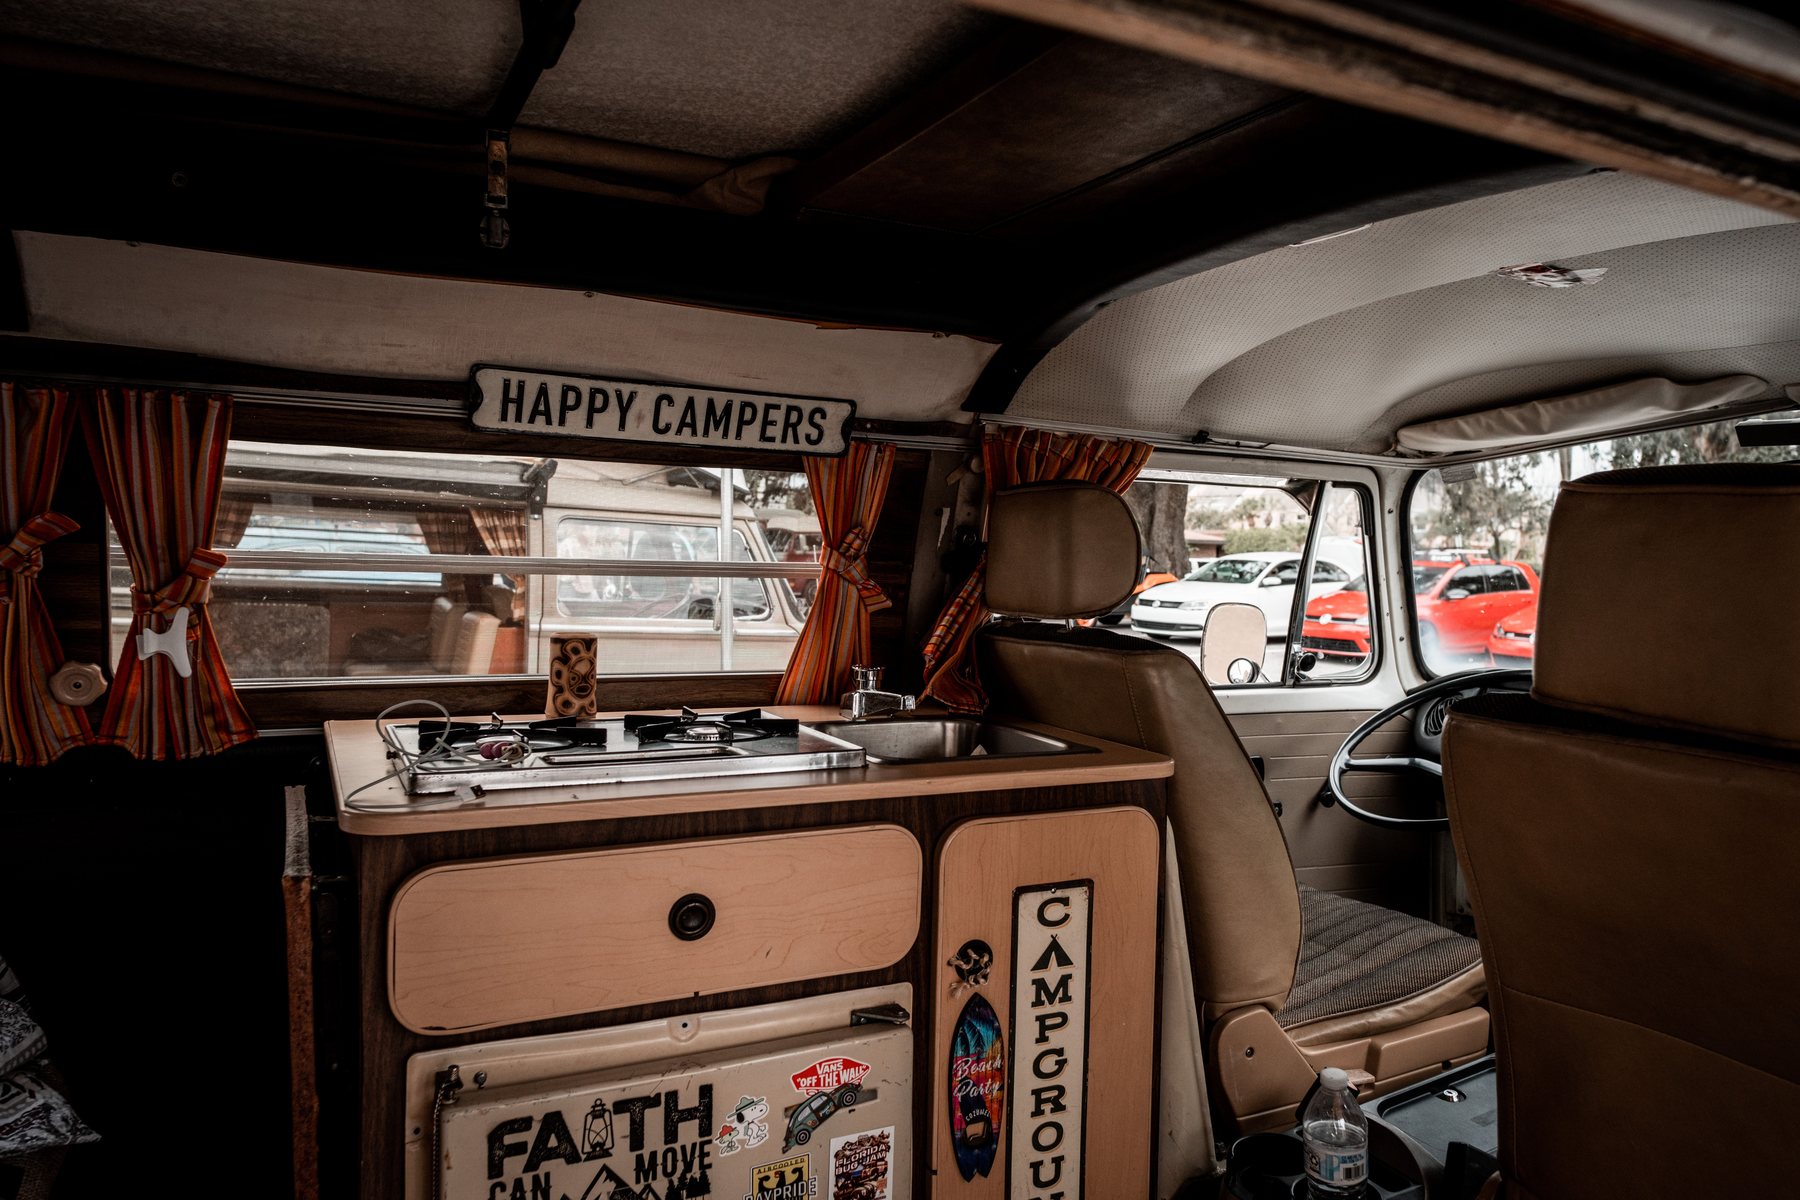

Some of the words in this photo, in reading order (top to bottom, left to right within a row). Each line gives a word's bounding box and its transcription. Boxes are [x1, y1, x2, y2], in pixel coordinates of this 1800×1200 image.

[499, 378, 638, 432] HAPPY
[651, 394, 828, 446] CAMPERS
[1028, 896, 1074, 1200] CAMPGROU
[816, 1059, 843, 1075] VANS
[953, 1054, 1002, 1080] Beach
[819, 1071, 838, 1087] THE
[953, 1078, 1002, 1102] Party
[756, 1158, 805, 1174] AIRCOOLED
[836, 1144, 886, 1167] FLORIDA
[488, 1171, 551, 1200] CAN
[634, 1139, 713, 1185] MOVE
[745, 1177, 817, 1200] AYPRIDE
